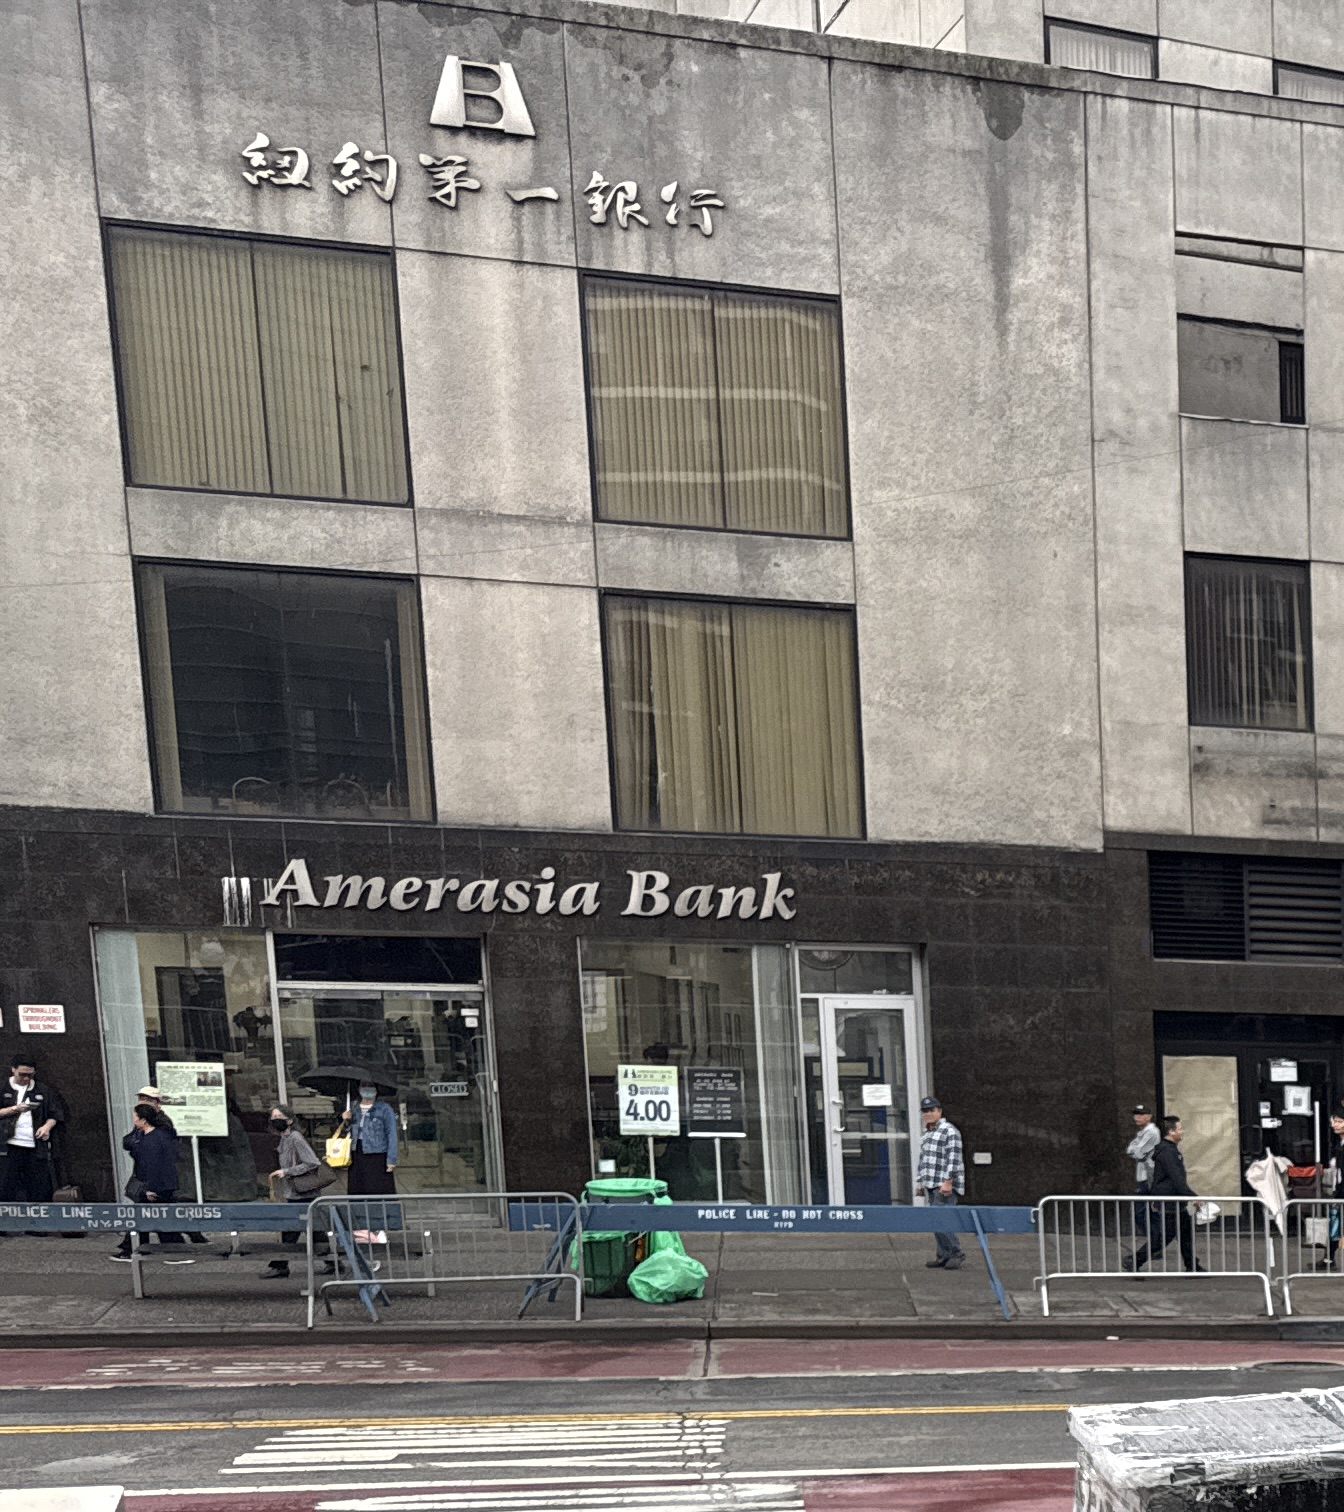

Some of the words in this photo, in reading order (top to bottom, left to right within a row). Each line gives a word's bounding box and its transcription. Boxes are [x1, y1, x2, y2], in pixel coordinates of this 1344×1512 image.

[258, 858, 601, 917] Amerasia
[621, 869, 798, 922] Bank
[628, 1083, 639, 1097] 9
[625, 1099, 671, 1122] 4.00
[0, 1206, 49, 1218] POLICE
[62, 1206, 94, 1218] LINE
[117, 1207, 136, 1218] DO
[142, 1207, 169, 1218] NOT
[175, 1207, 222, 1219] CROSS
[697, 1208, 737, 1220] POLICE
